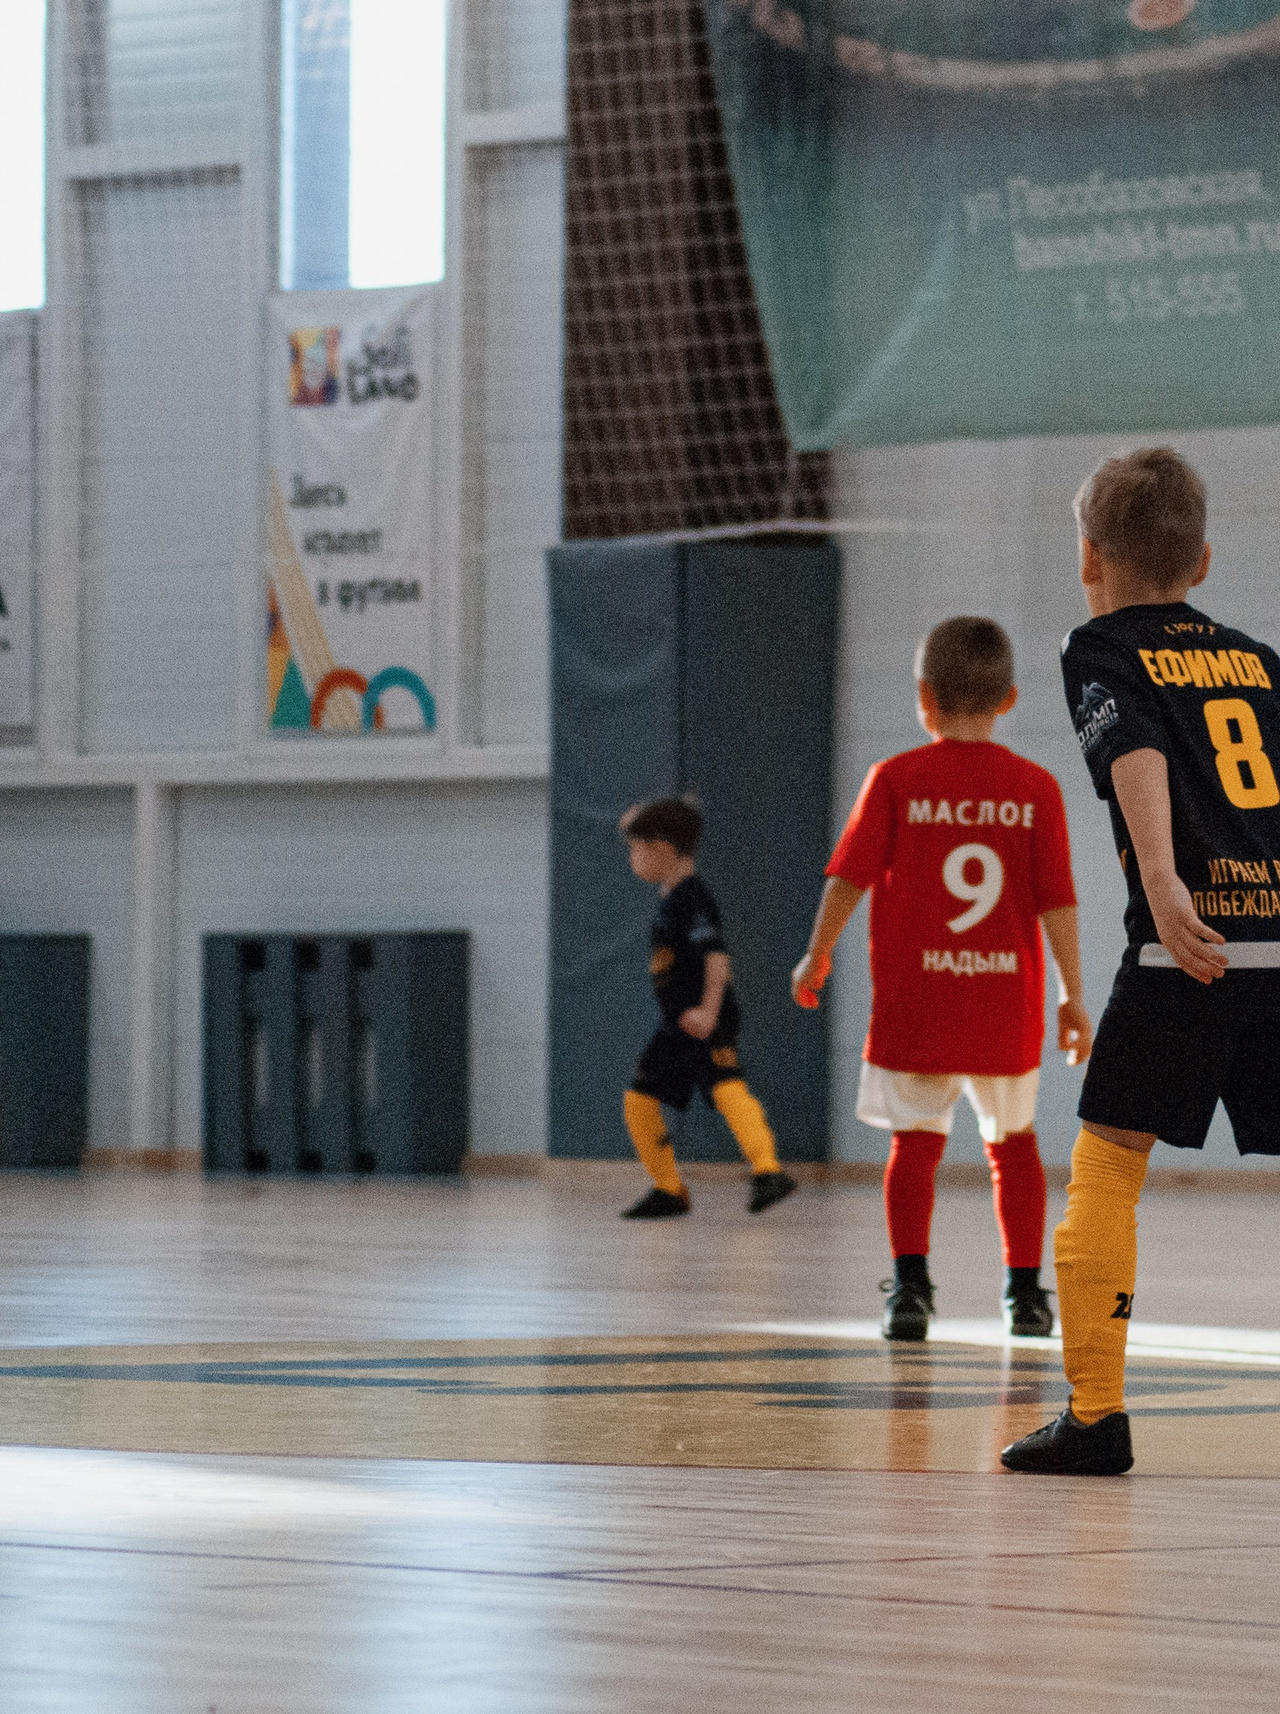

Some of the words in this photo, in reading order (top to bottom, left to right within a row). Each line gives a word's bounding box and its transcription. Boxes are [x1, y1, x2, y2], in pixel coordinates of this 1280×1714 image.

[1138, 648, 1272, 690] ЕФИМОВ
[1203, 697, 1280, 810] 8
[942, 842, 1005, 935] 9
[1207, 857, 1271, 885] ИГРАЕМ
[922, 950, 1018, 977] НАДЫМ
[1110, 1291, 1134, 1320] 2
